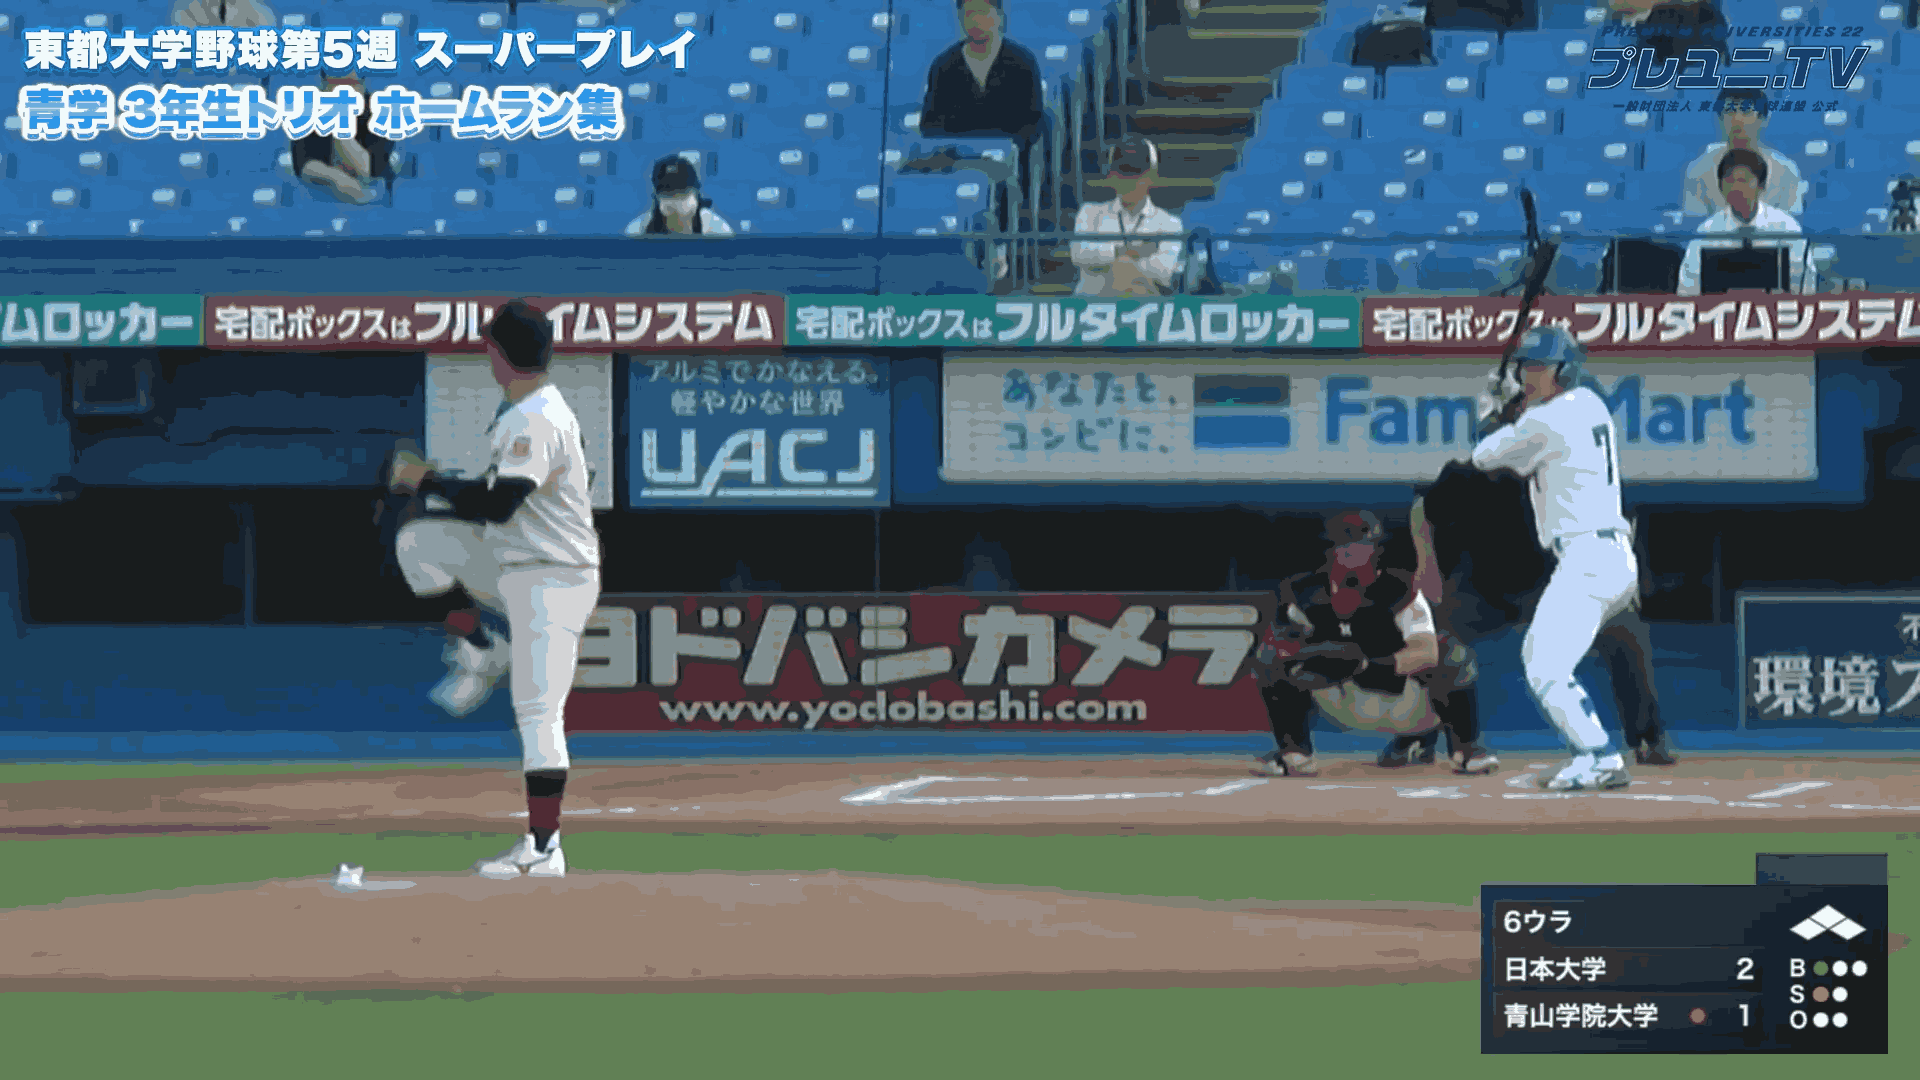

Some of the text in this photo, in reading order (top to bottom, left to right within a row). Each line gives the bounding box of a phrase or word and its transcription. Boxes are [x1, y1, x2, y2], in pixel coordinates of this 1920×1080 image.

[1, 302, 194, 342] ムロッカー
[214, 300, 774, 344] 宅配ボックスはフルイムシステム
[795, 301, 1351, 343] 宅配ボックスはフルタイムロッカー
[641, 427, 875, 498] UACJ
[572, 604, 1260, 688] ヨドバシカメラ
[658, 690, 1149, 730] www.yodobashi.com
